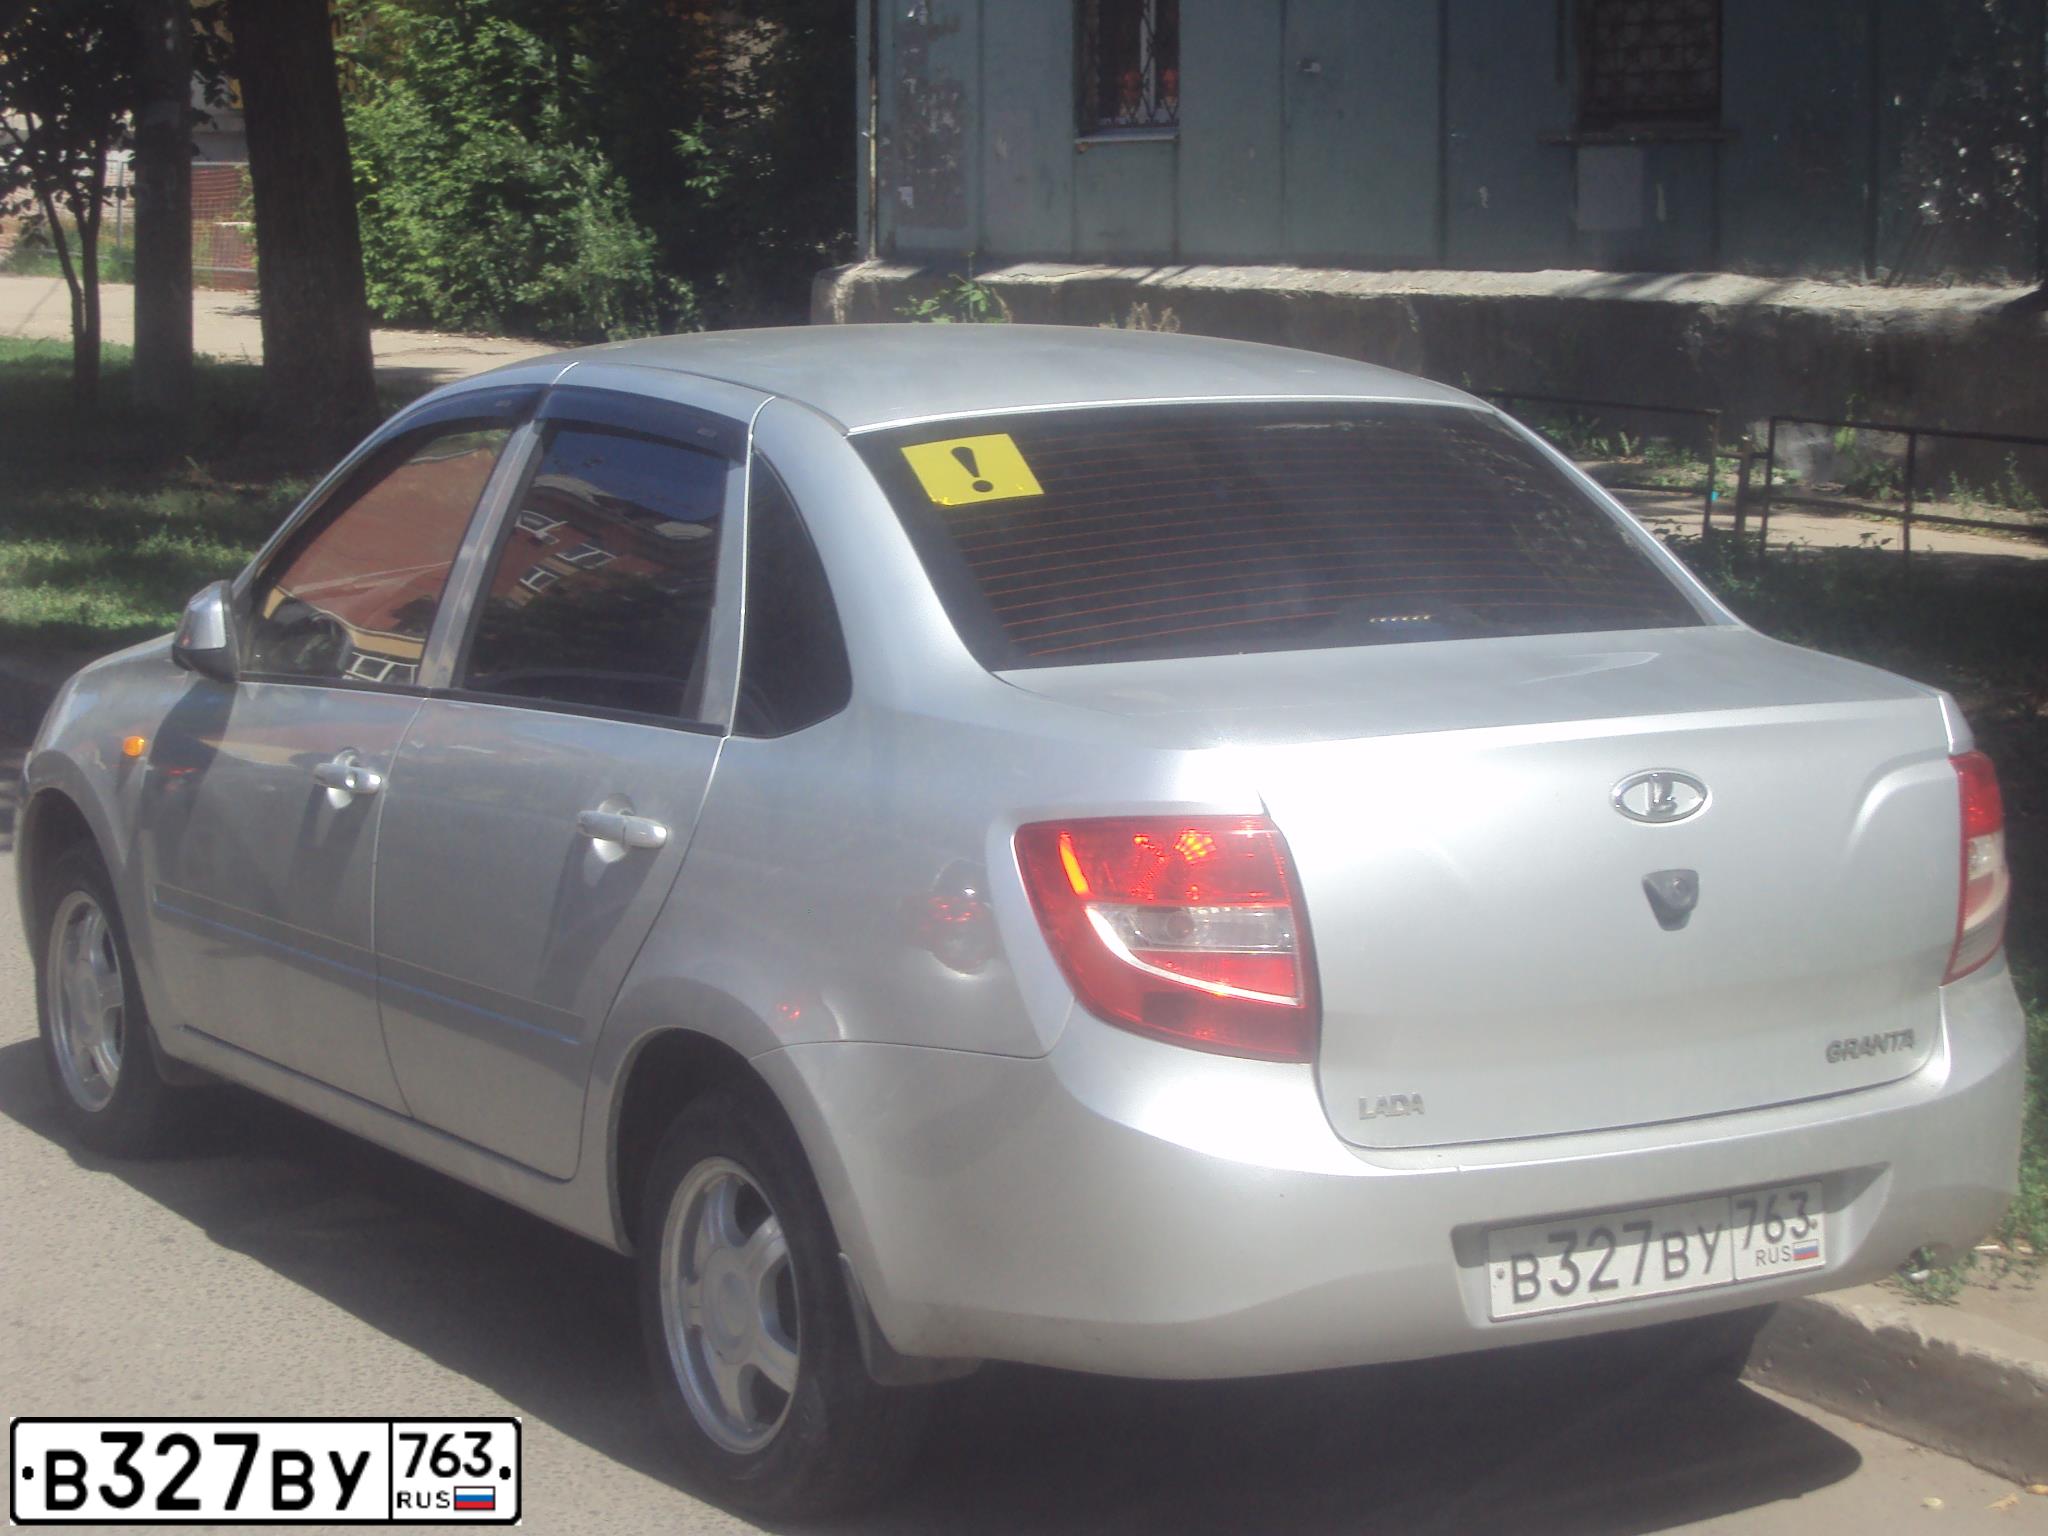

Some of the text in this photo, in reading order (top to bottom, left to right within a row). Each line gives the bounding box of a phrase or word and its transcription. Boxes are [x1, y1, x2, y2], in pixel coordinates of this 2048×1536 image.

[1825, 1028, 1915, 1064] GRANTA
[1358, 1093, 1425, 1120] LADA
[1736, 1190, 1812, 1250] 763
[1755, 1245, 1792, 1267] RUS
